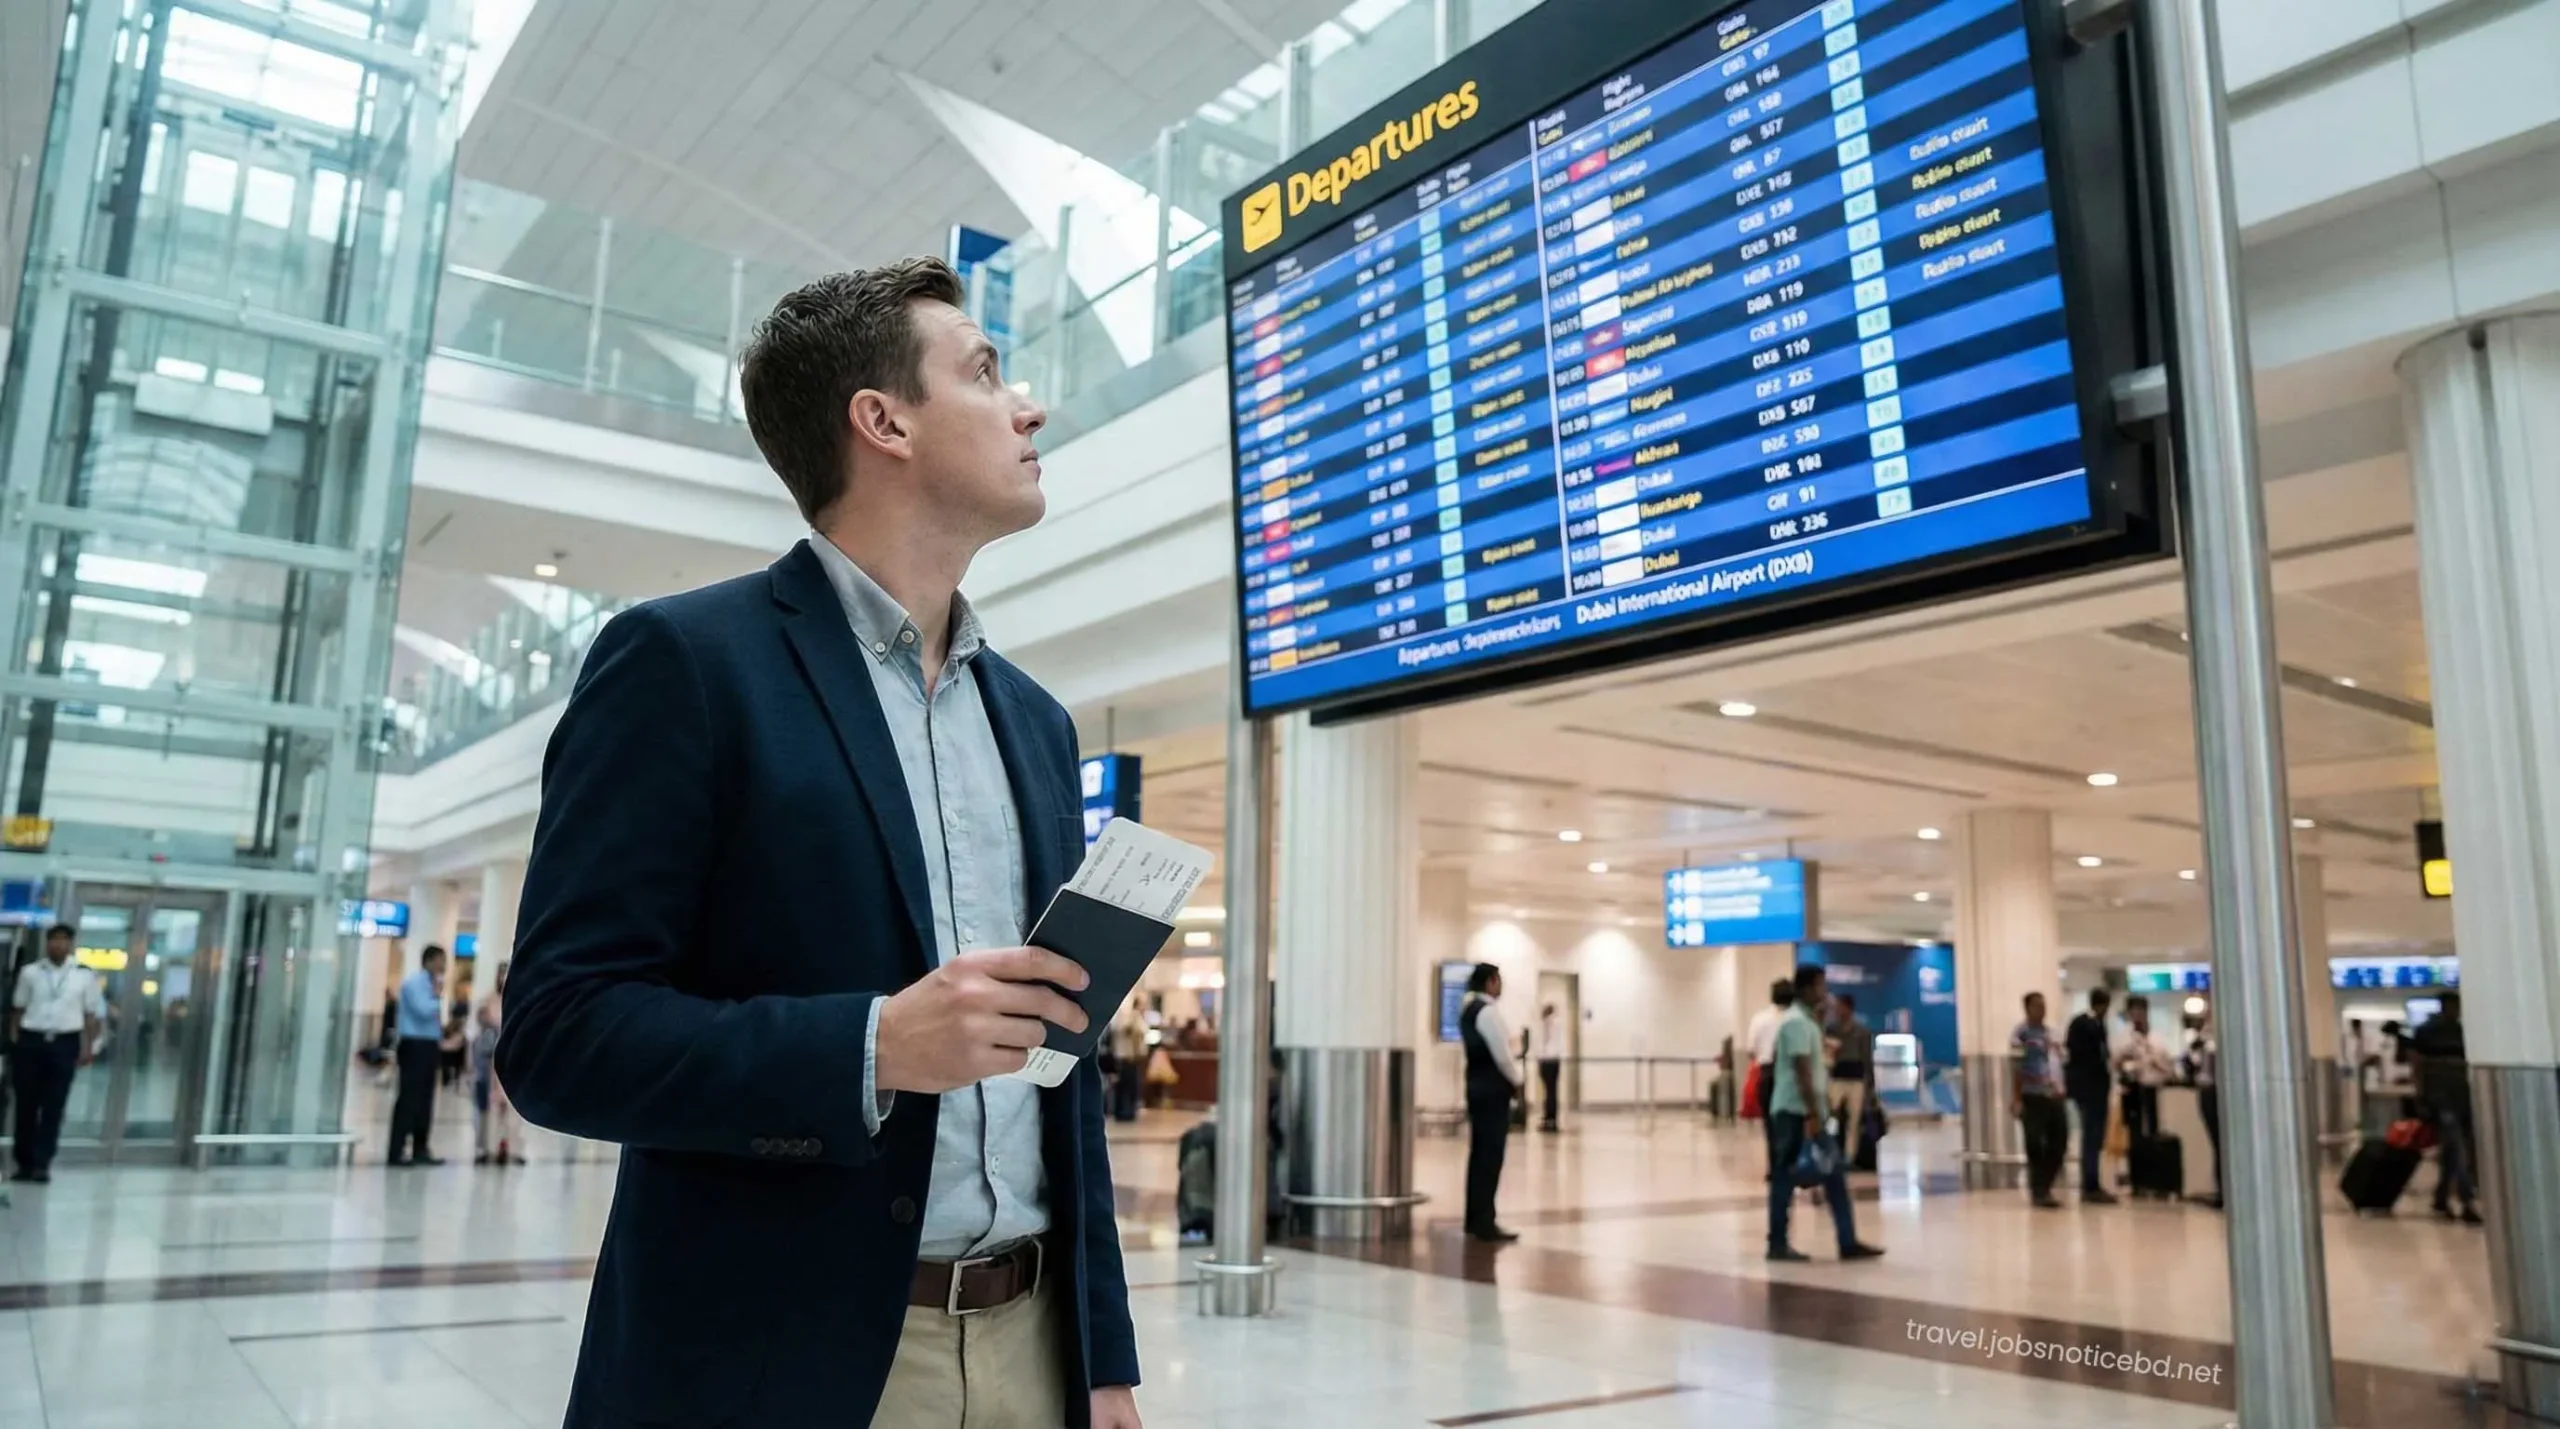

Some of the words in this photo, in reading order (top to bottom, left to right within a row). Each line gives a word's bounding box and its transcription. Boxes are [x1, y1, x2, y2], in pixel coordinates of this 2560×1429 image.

[1287, 79, 1481, 217] Departures
[1576, 598, 1616, 623] Dubai
[1617, 575, 1708, 613] International
[1711, 564, 1764, 591] Airport
[1767, 550, 1813, 580] (DXB)
[1643, 550, 1679, 572] Dubai
